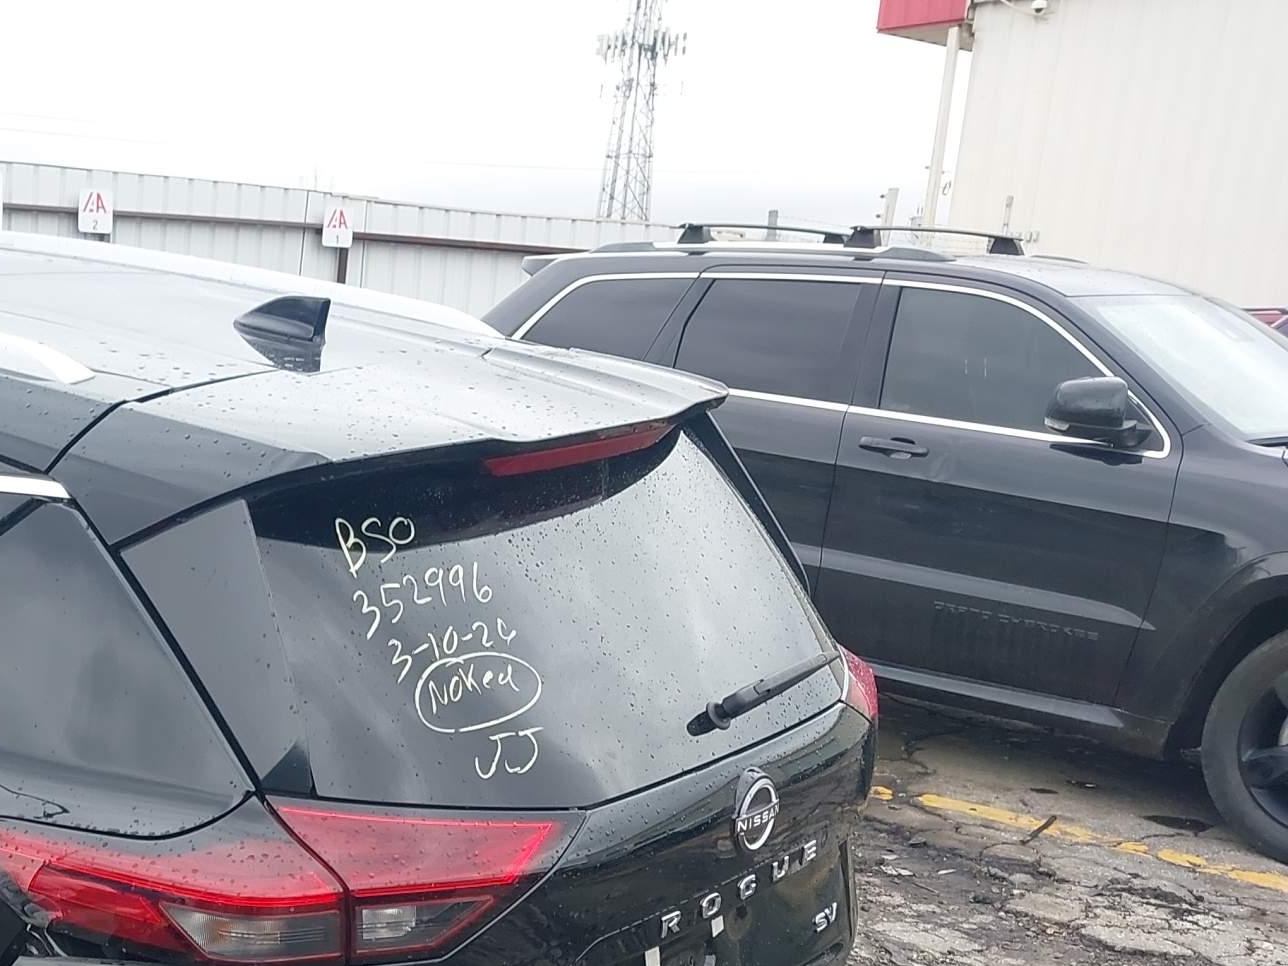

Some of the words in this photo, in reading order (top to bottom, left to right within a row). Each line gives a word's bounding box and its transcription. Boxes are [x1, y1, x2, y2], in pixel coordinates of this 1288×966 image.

[92, 219, 98, 231] 2
[737, 803, 780, 833] NISSAN
[661, 839, 817, 938] ROGUE
[813, 902, 838, 933] SV
